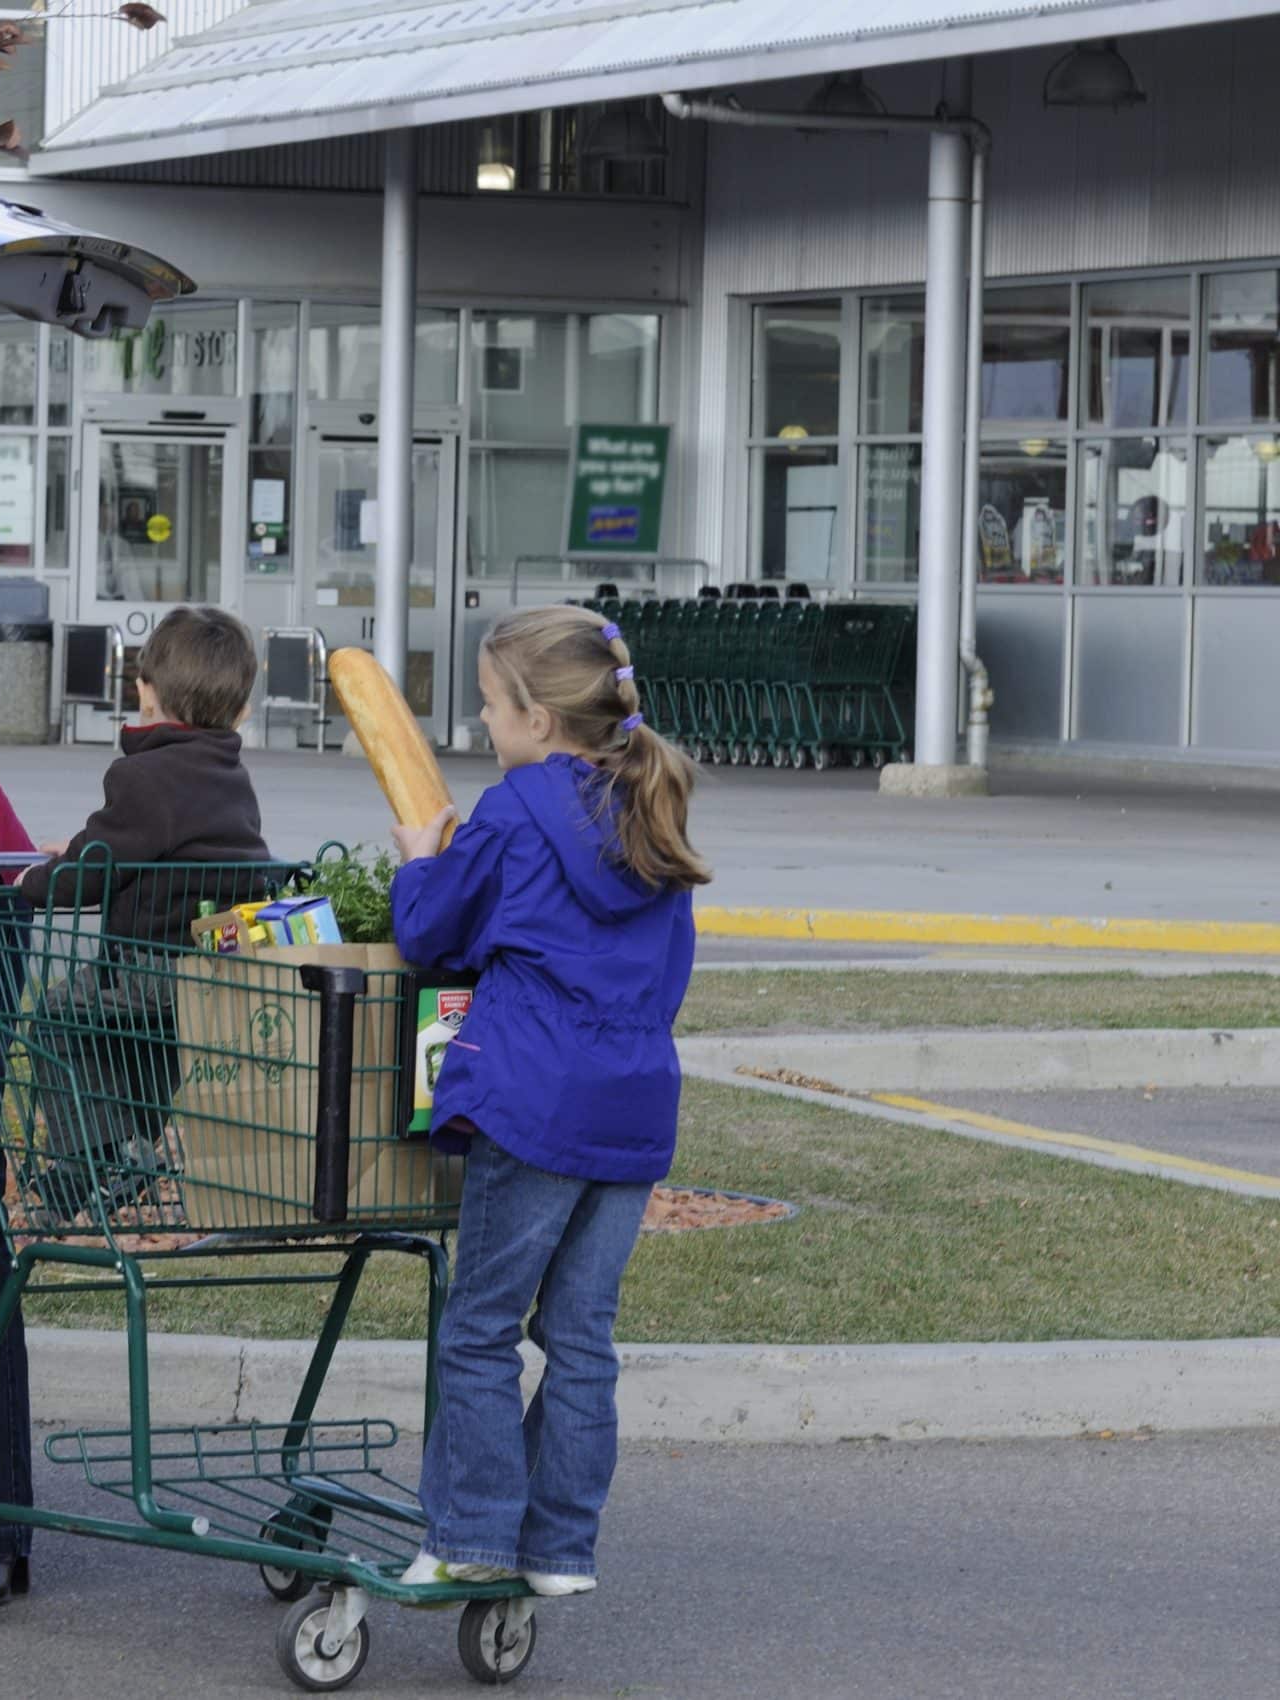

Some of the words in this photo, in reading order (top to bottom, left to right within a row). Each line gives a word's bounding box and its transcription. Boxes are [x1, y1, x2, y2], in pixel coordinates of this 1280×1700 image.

[587, 437, 626, 453] What
[630, 442, 655, 456] are
[578, 461, 606, 478] you
[609, 460, 660, 478] saving
[589, 481, 609, 497] up
